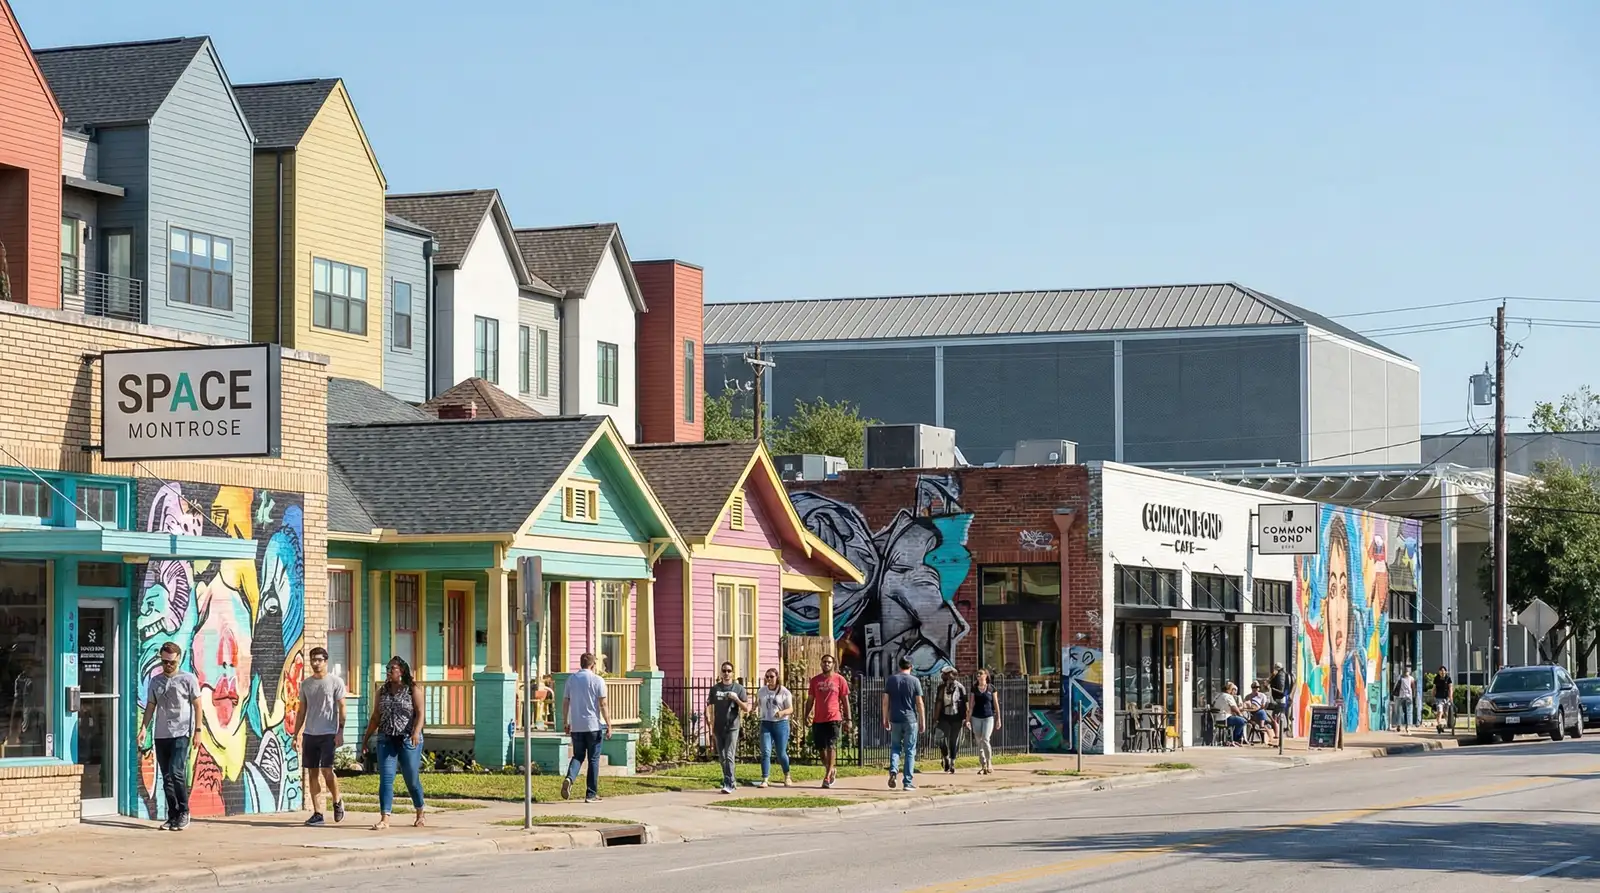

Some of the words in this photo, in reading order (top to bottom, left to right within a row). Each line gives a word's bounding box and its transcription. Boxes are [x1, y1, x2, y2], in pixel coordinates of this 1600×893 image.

[118, 369, 252, 414] SPACE
[129, 419, 241, 439] MONTROSE
[1263, 526, 1312, 534] COMMON
[1174, 539, 1195, 554] CAFE
[1273, 535, 1303, 543] BOND
